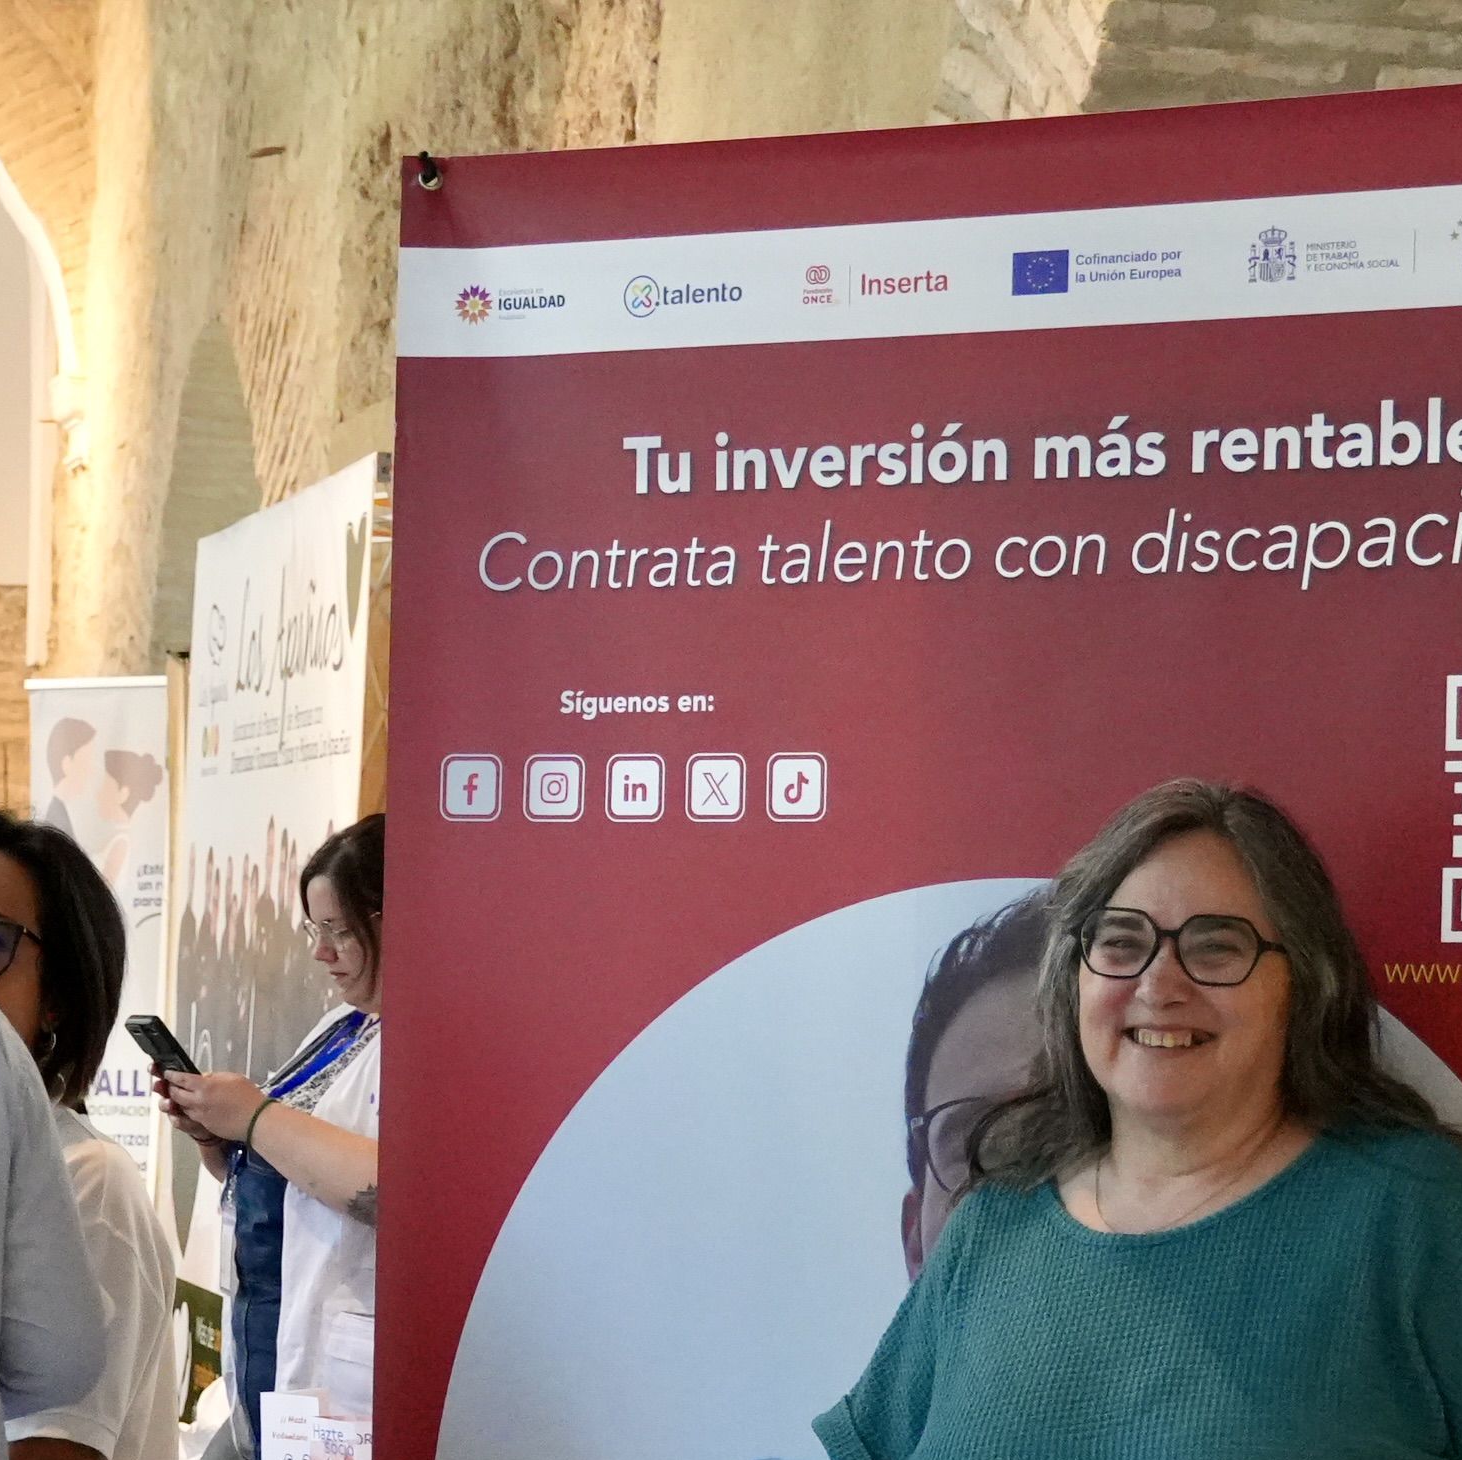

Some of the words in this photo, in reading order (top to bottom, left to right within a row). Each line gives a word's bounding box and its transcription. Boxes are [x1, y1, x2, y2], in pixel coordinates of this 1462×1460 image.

[1306, 240, 1357, 251] MINISTERIO
[1075, 250, 1158, 266] Cofinanciado
[1161, 250, 1183, 265] por
[1306, 252, 1319, 262] DE
[1321, 250, 1360, 262] TRABAJO
[1367, 258, 1400, 269] SOCIAL
[1075, 270, 1086, 283] la
[1089, 267, 1126, 283] Unión
[1129, 267, 1182, 283] Europea
[861, 271, 948, 297] Inserta
[498, 294, 566, 311] IGUALDAD
[802, 296, 833, 305] ONCE
[622, 435, 691, 494] Tu
[714, 422, 1008, 491] inversión
[1034, 415, 1166, 479] más
[479, 531, 736, 592] Contrata
[758, 519, 971, 585] talento
[994, 531, 1106, 578] con
[560, 690, 669, 720] Síguenos
[677, 693, 715, 713] en:
